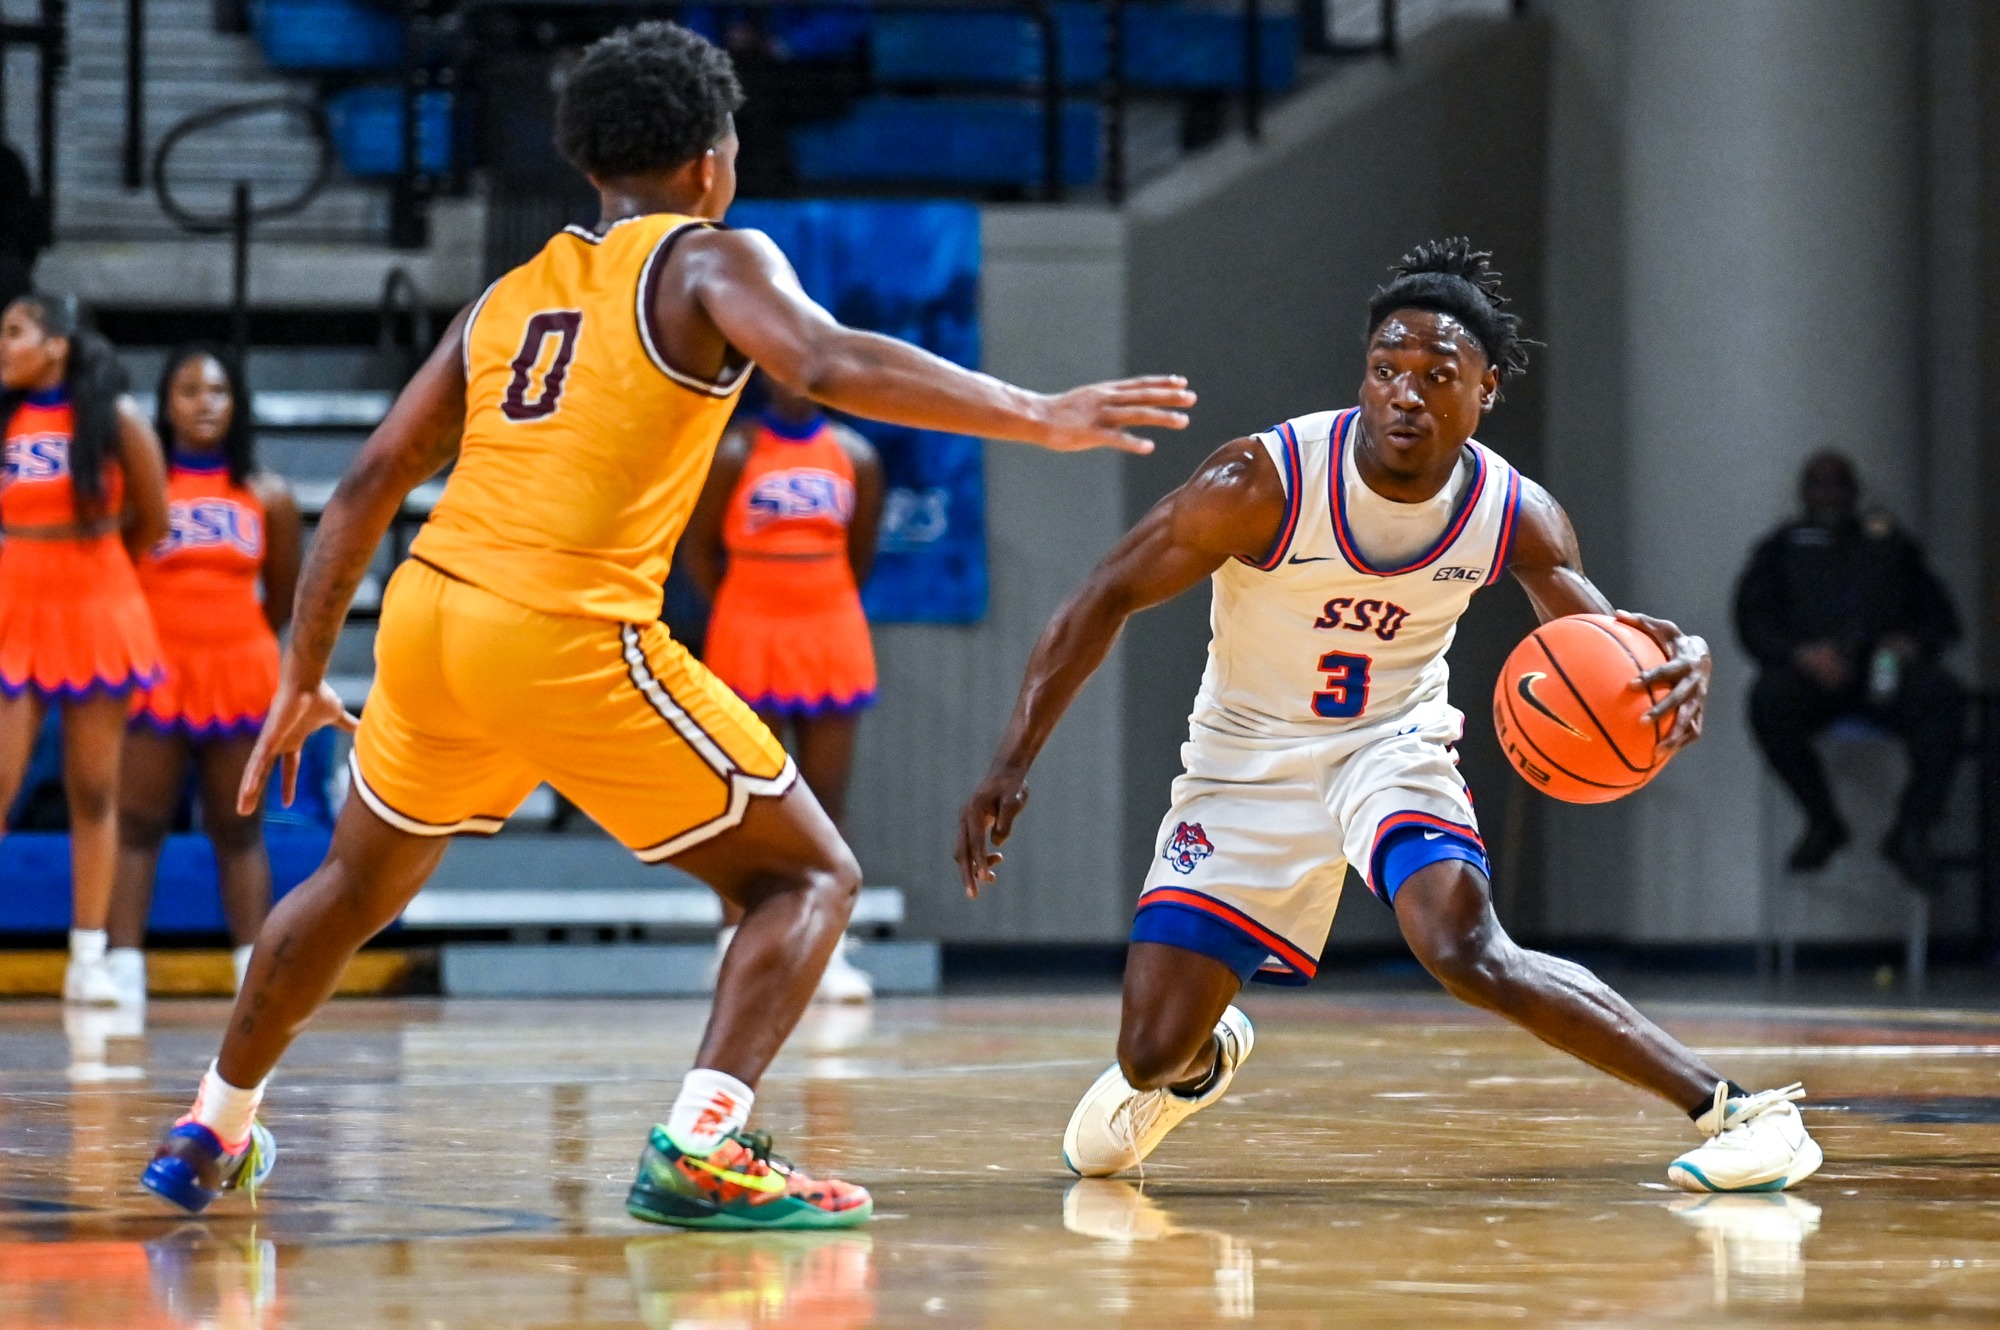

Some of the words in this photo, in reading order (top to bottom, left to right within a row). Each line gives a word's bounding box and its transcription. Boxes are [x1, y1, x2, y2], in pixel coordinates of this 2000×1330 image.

[500, 309, 582, 423] 0
[1313, 598, 1411, 641] SSU
[1311, 650, 1373, 718] 3
